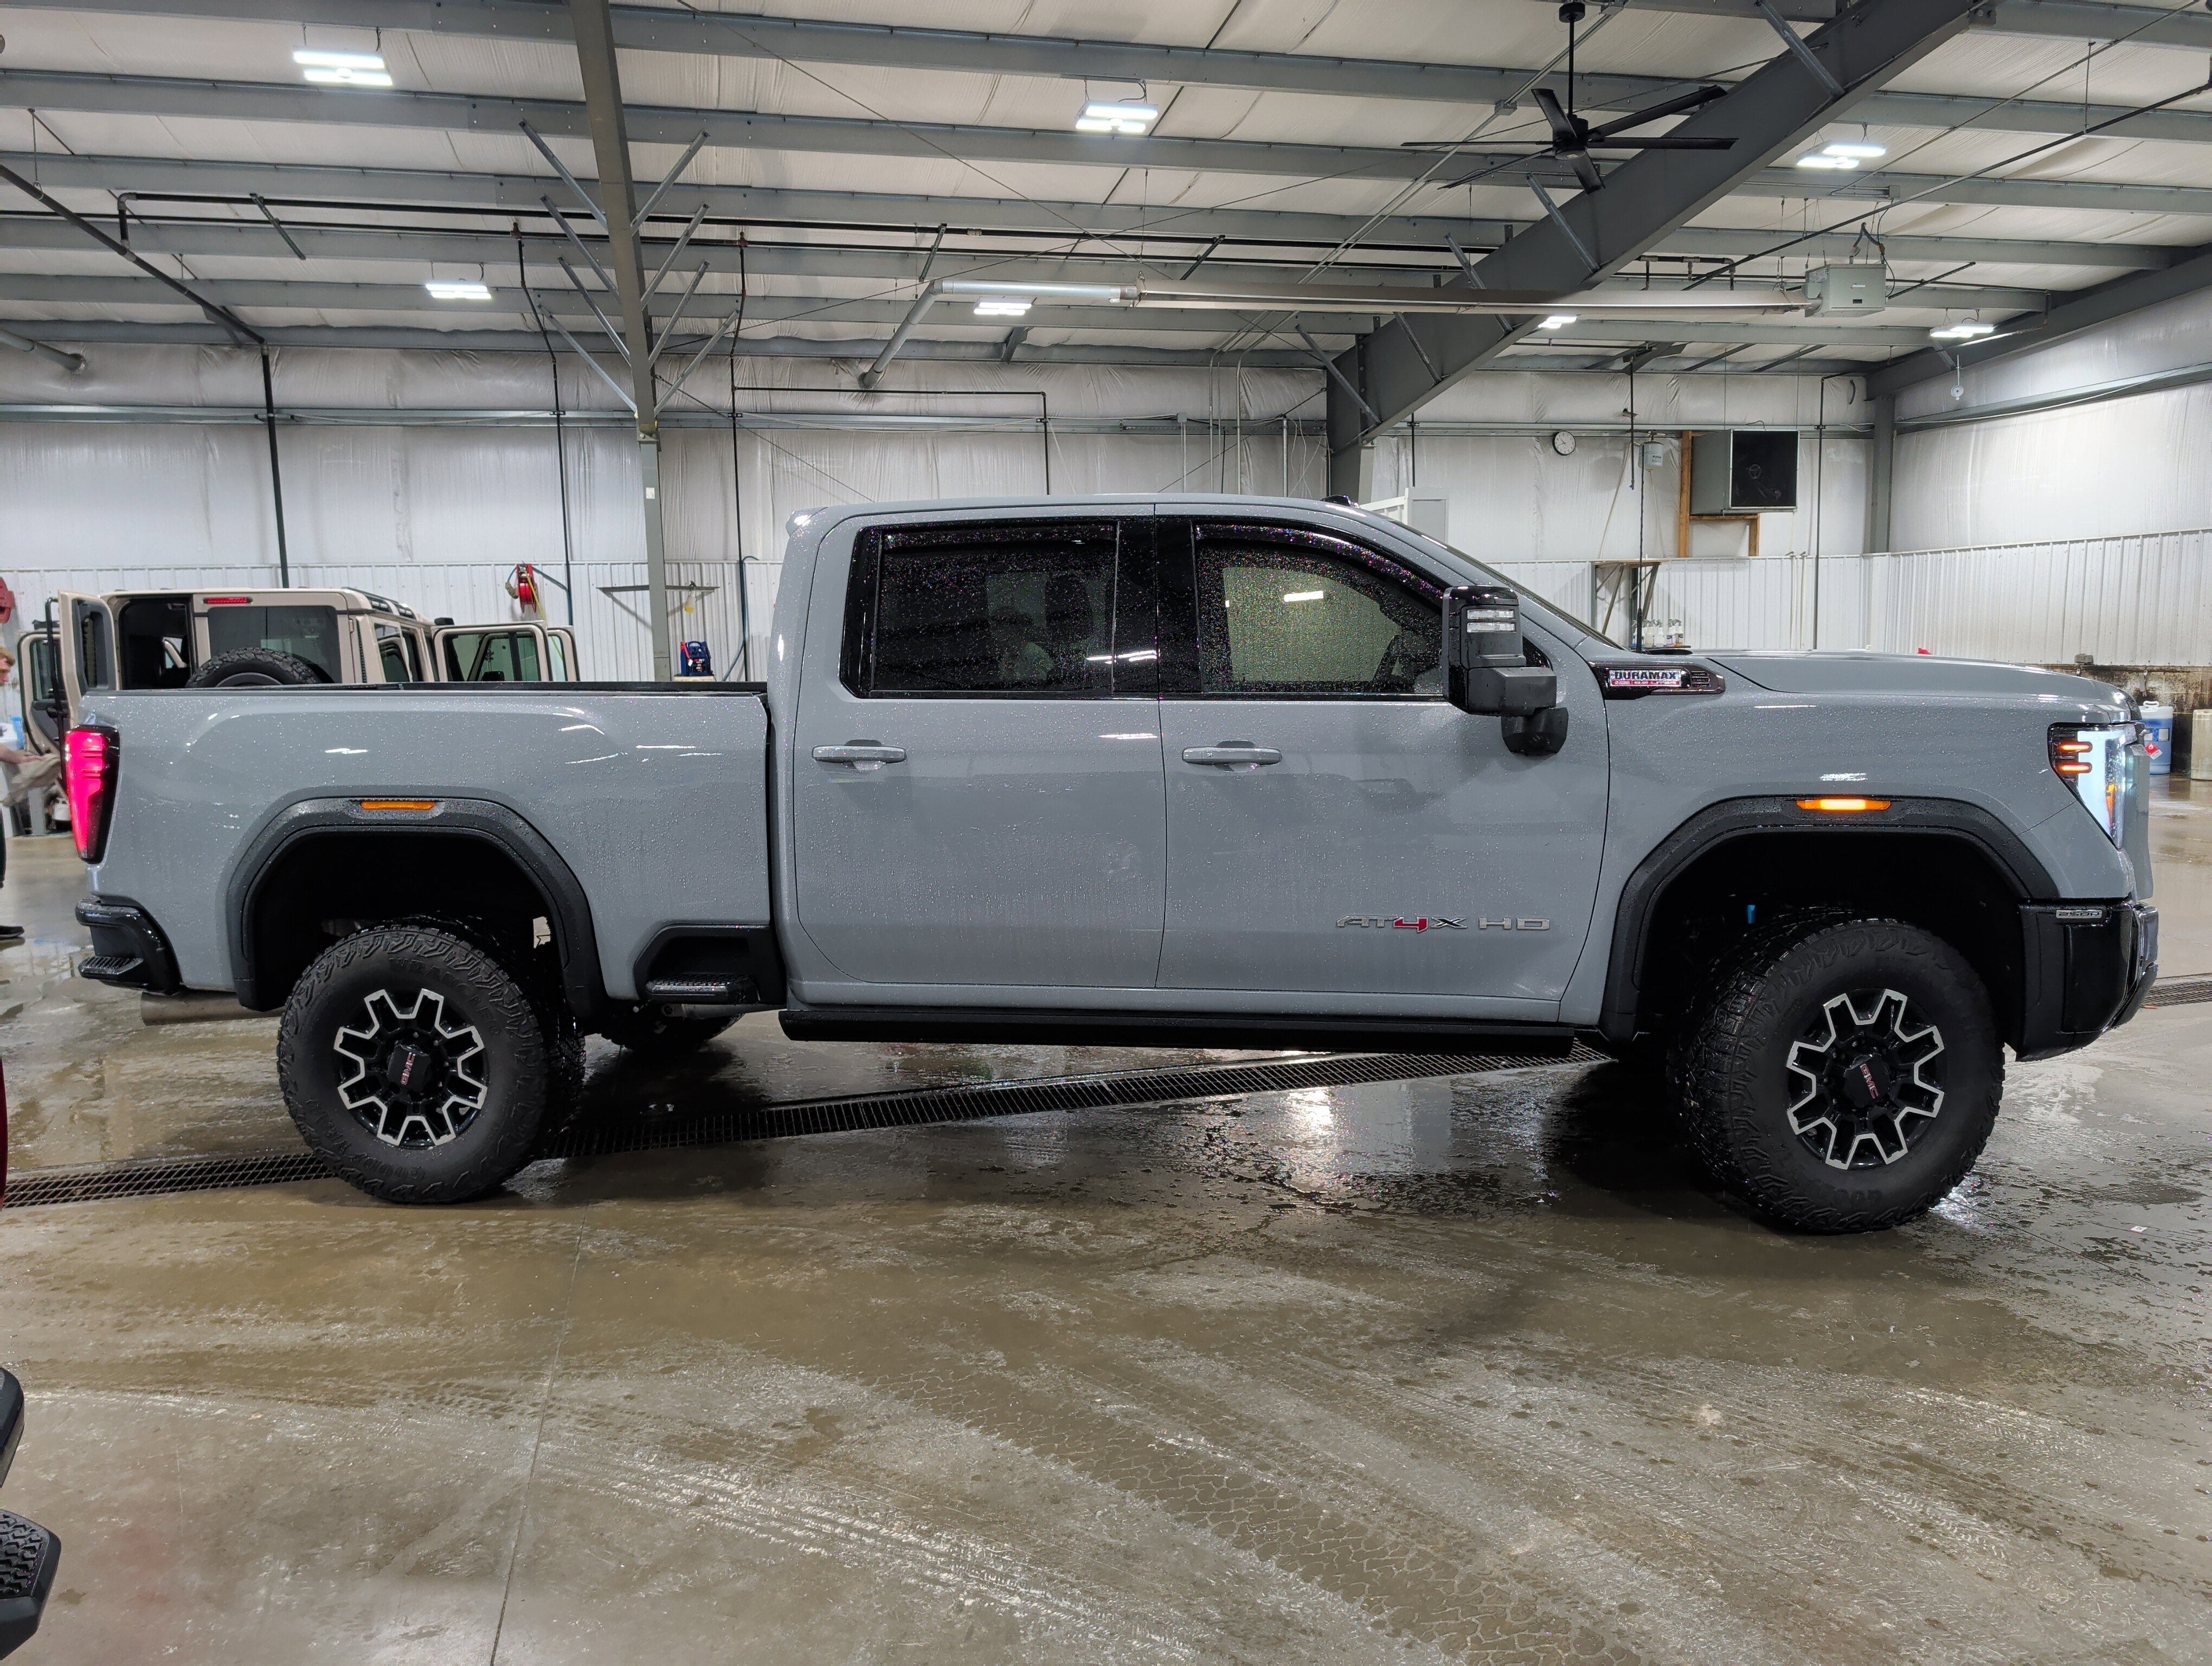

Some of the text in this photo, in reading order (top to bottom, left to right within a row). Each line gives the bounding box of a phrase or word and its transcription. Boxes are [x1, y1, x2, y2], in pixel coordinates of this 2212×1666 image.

[1614, 671, 1677, 680] DURAMAX
[1336, 915, 1550, 933] AT4X HD
[400, 1052, 416, 1085] GMC
[1860, 1063, 1880, 1099] GMC
